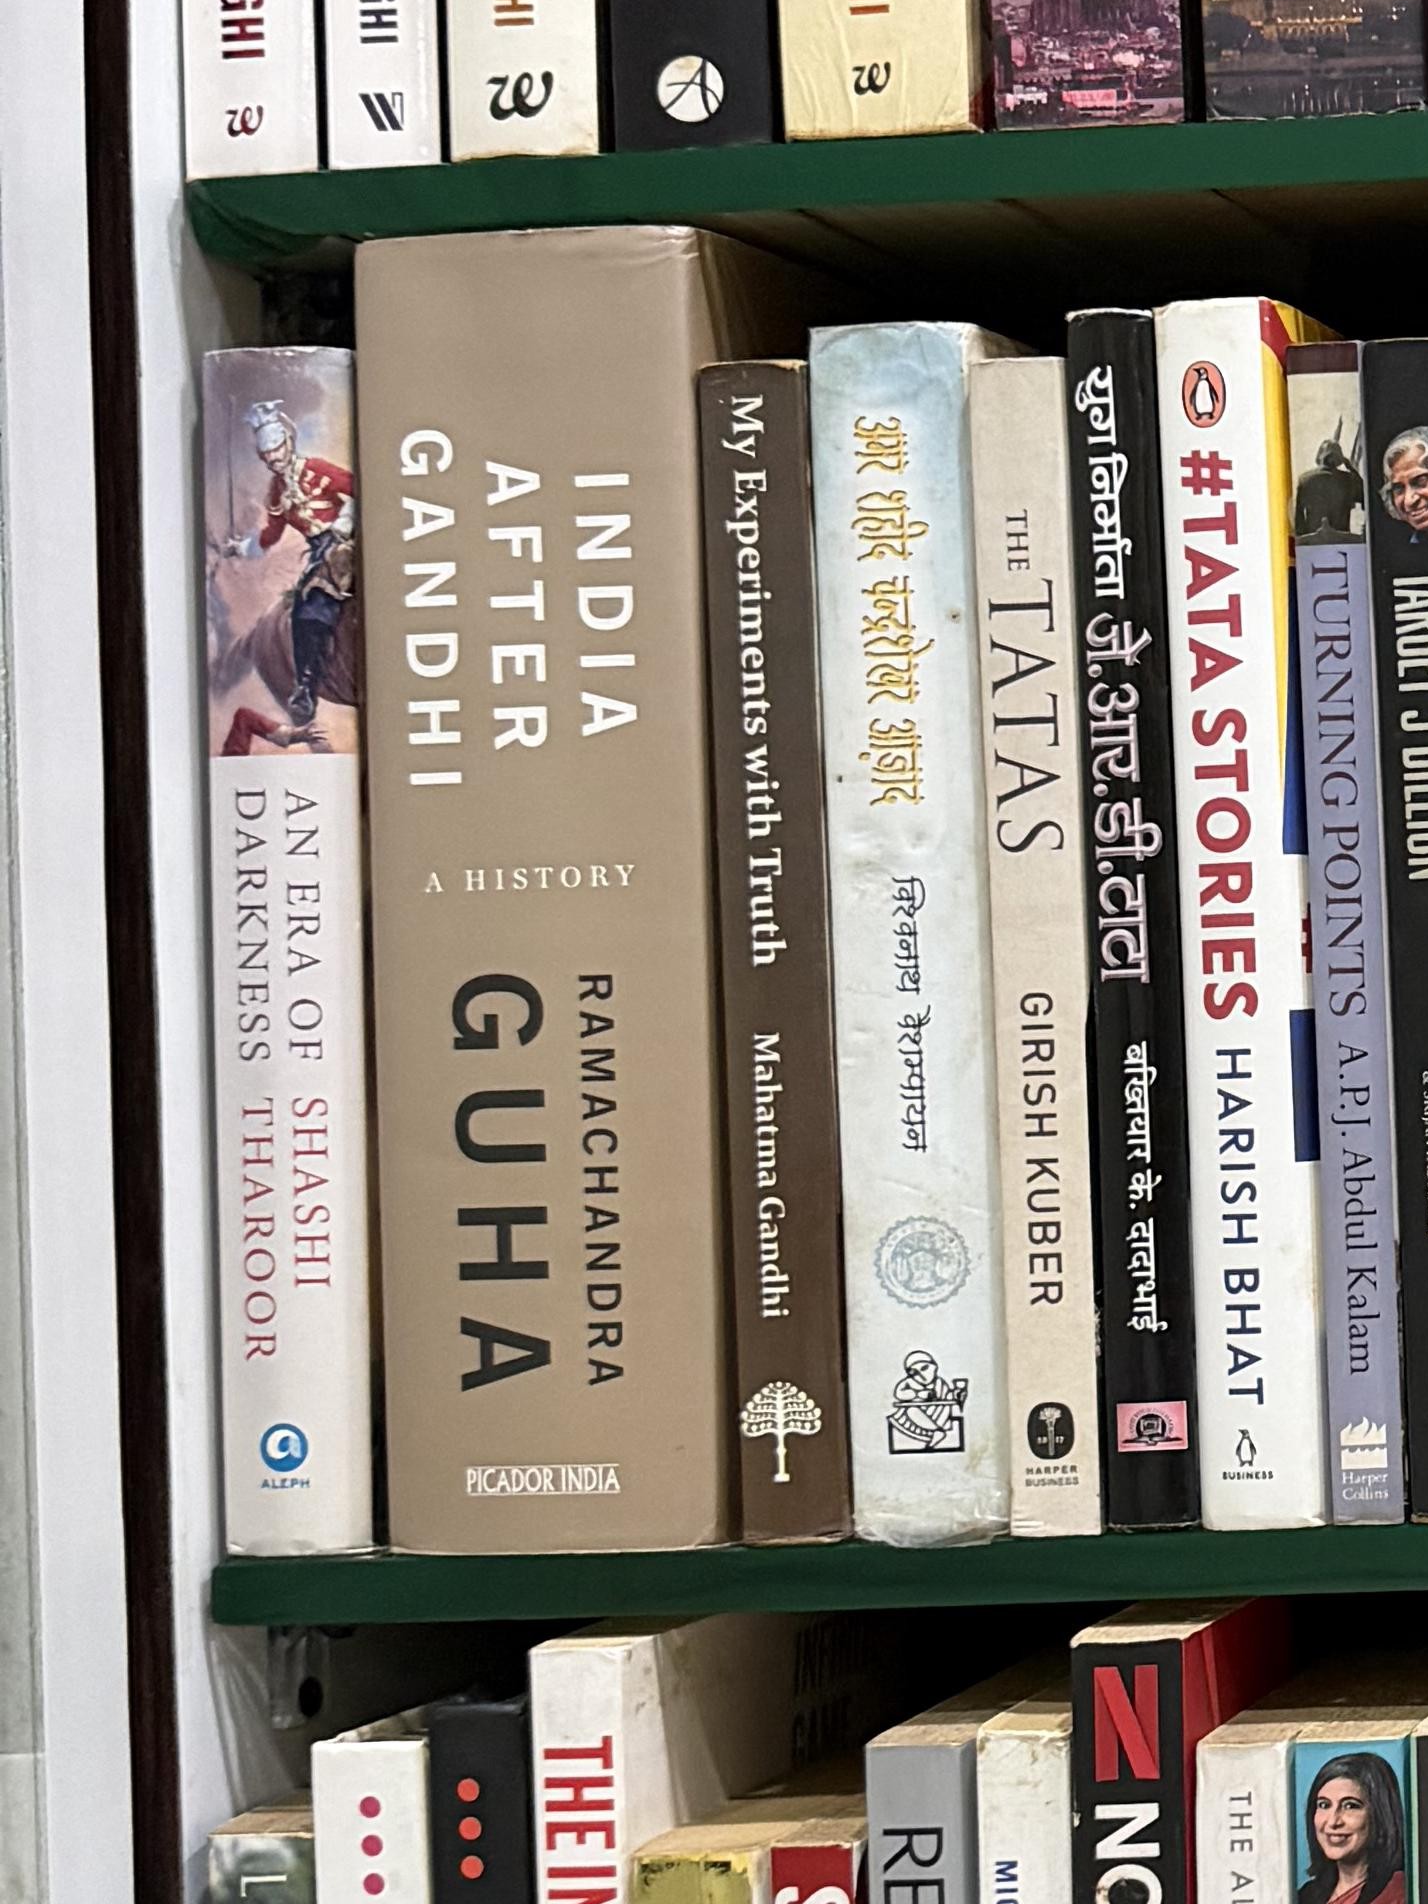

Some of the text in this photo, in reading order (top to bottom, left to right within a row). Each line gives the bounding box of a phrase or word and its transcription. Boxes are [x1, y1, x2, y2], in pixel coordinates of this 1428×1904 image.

[400, 427, 463, 789] GANDHI
[483, 457, 547, 752] AFTER
[573, 470, 640, 739] INDIA
[722, 394, 788, 968] My Experiments with Truth
[1006, 509, 1031, 573] THE
[989, 577, 1065, 859] TATAS
[1178, 450, 1257, 1023] #TATA STORIES
[452, 971, 553, 1394] GUHA
[576, 972, 625, 1390] RAMACHANDRA
[261, 1475, 311, 1491] ALEPH
[465, 1463, 621, 1496] PICADOR INDIA
